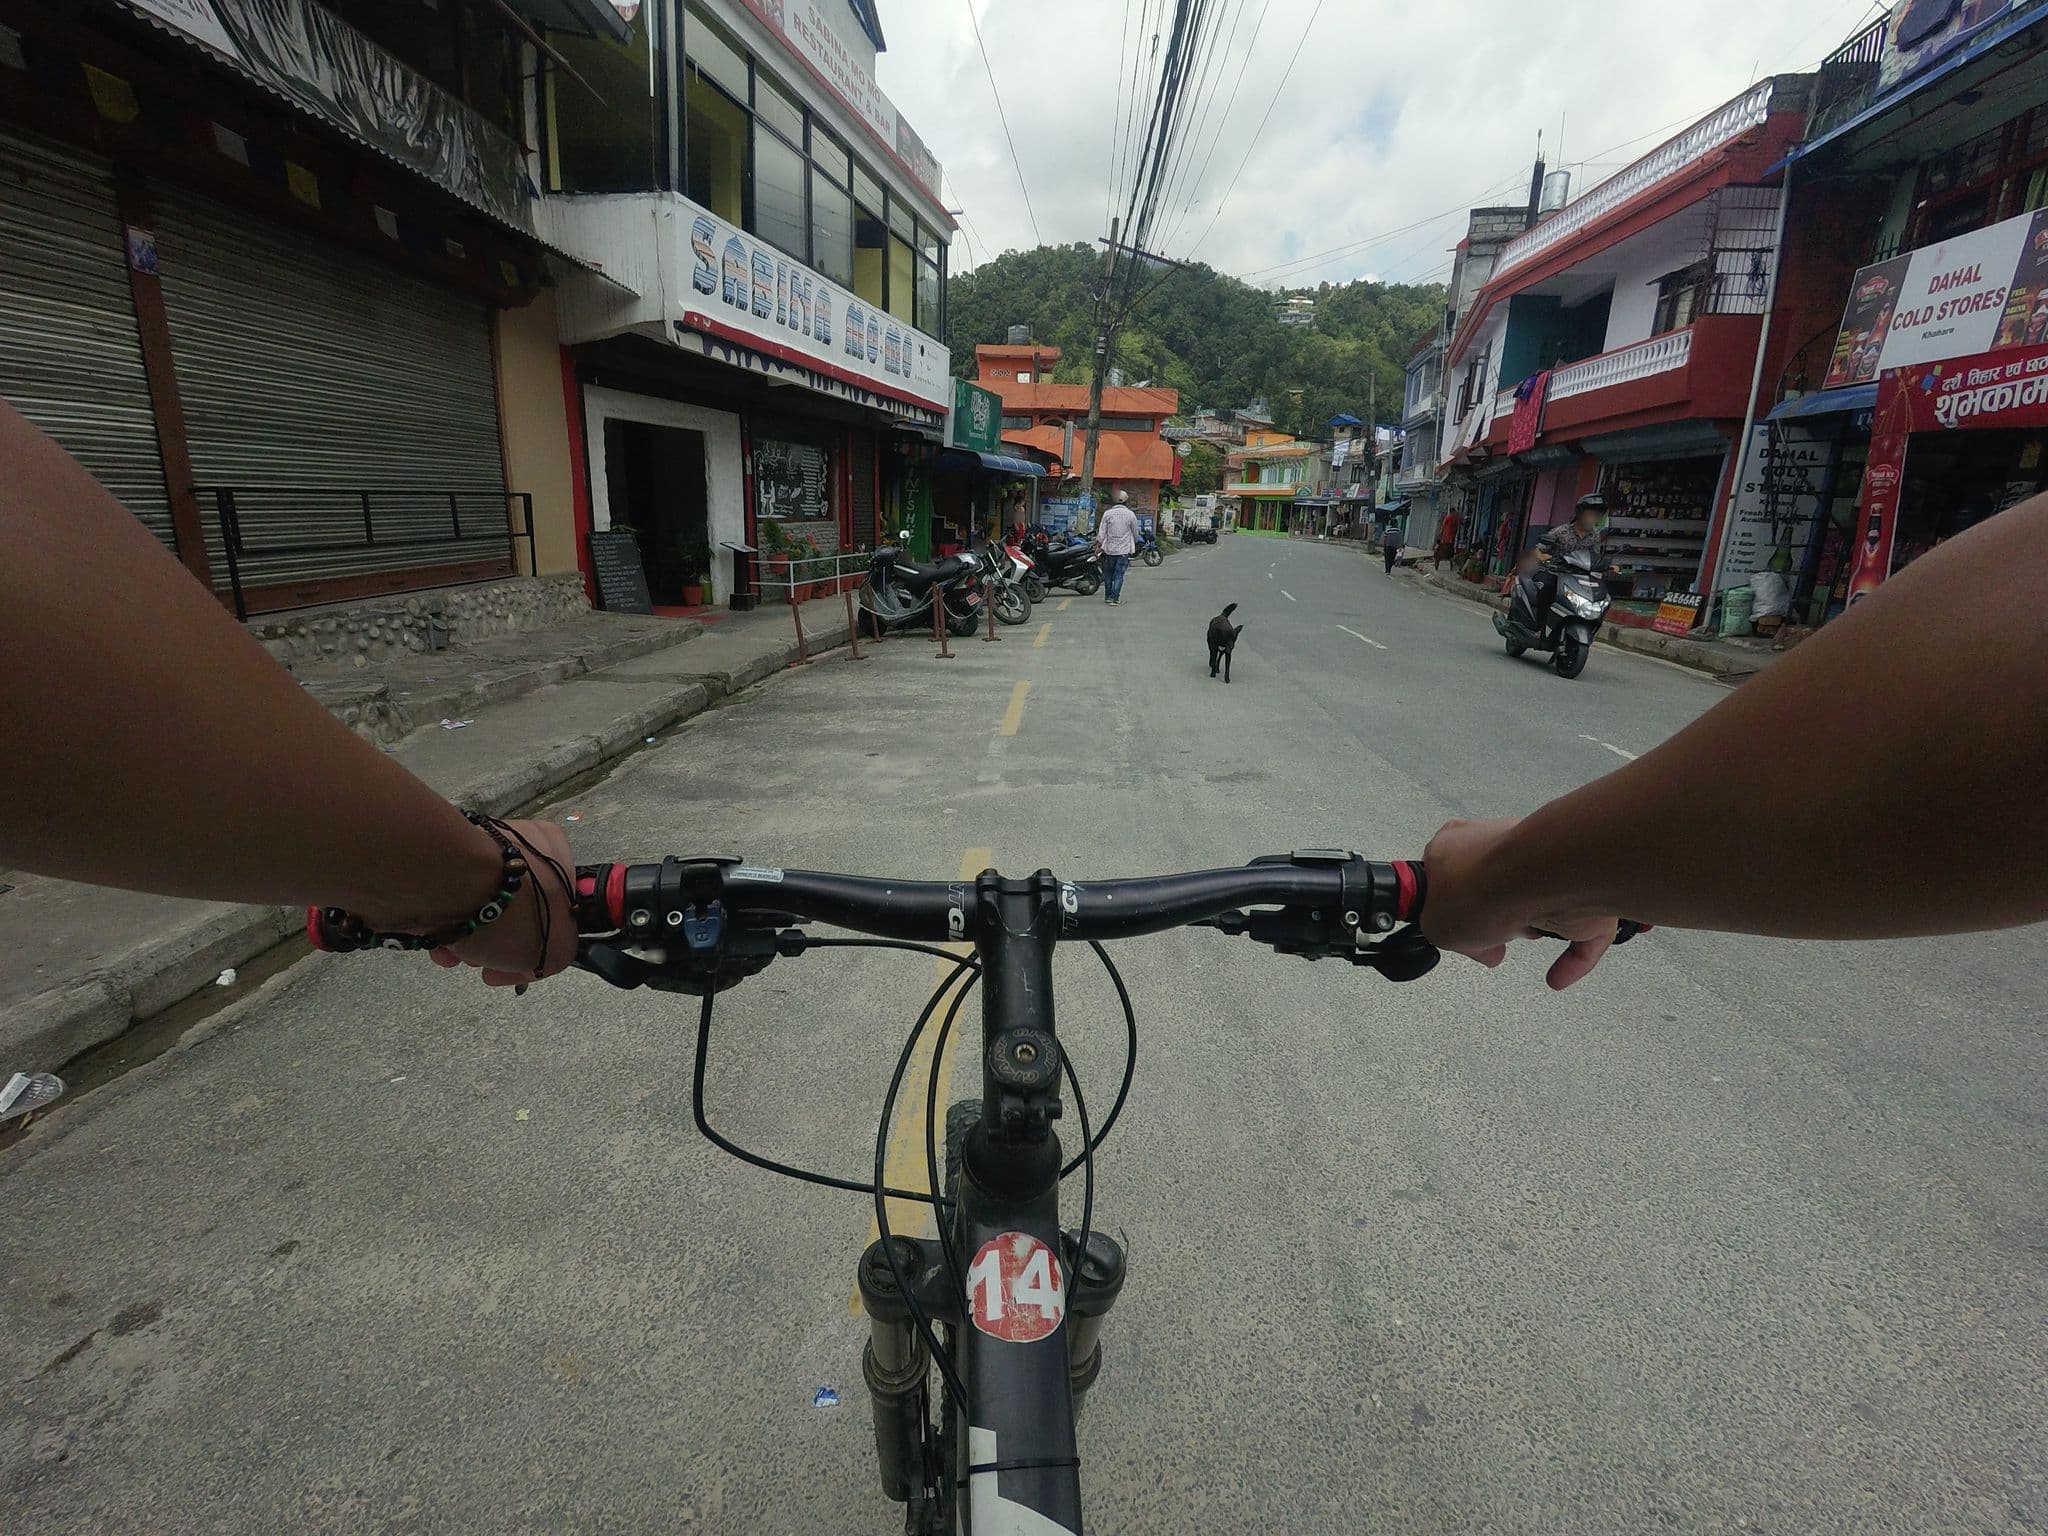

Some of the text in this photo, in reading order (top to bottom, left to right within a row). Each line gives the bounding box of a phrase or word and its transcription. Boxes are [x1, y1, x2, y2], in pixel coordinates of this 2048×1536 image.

[793, 12, 863, 103] RESTAURANT
[866, 100, 872, 114] &
[875, 109, 891, 136] BAR
[809, 5, 881, 103] SABINA MO MO
[691, 216, 832, 346] SABINA
[1892, 287, 2006, 331] COLD STORES
[1928, 264, 1982, 294] DAHAL
[967, 1249, 1064, 1321] 14
